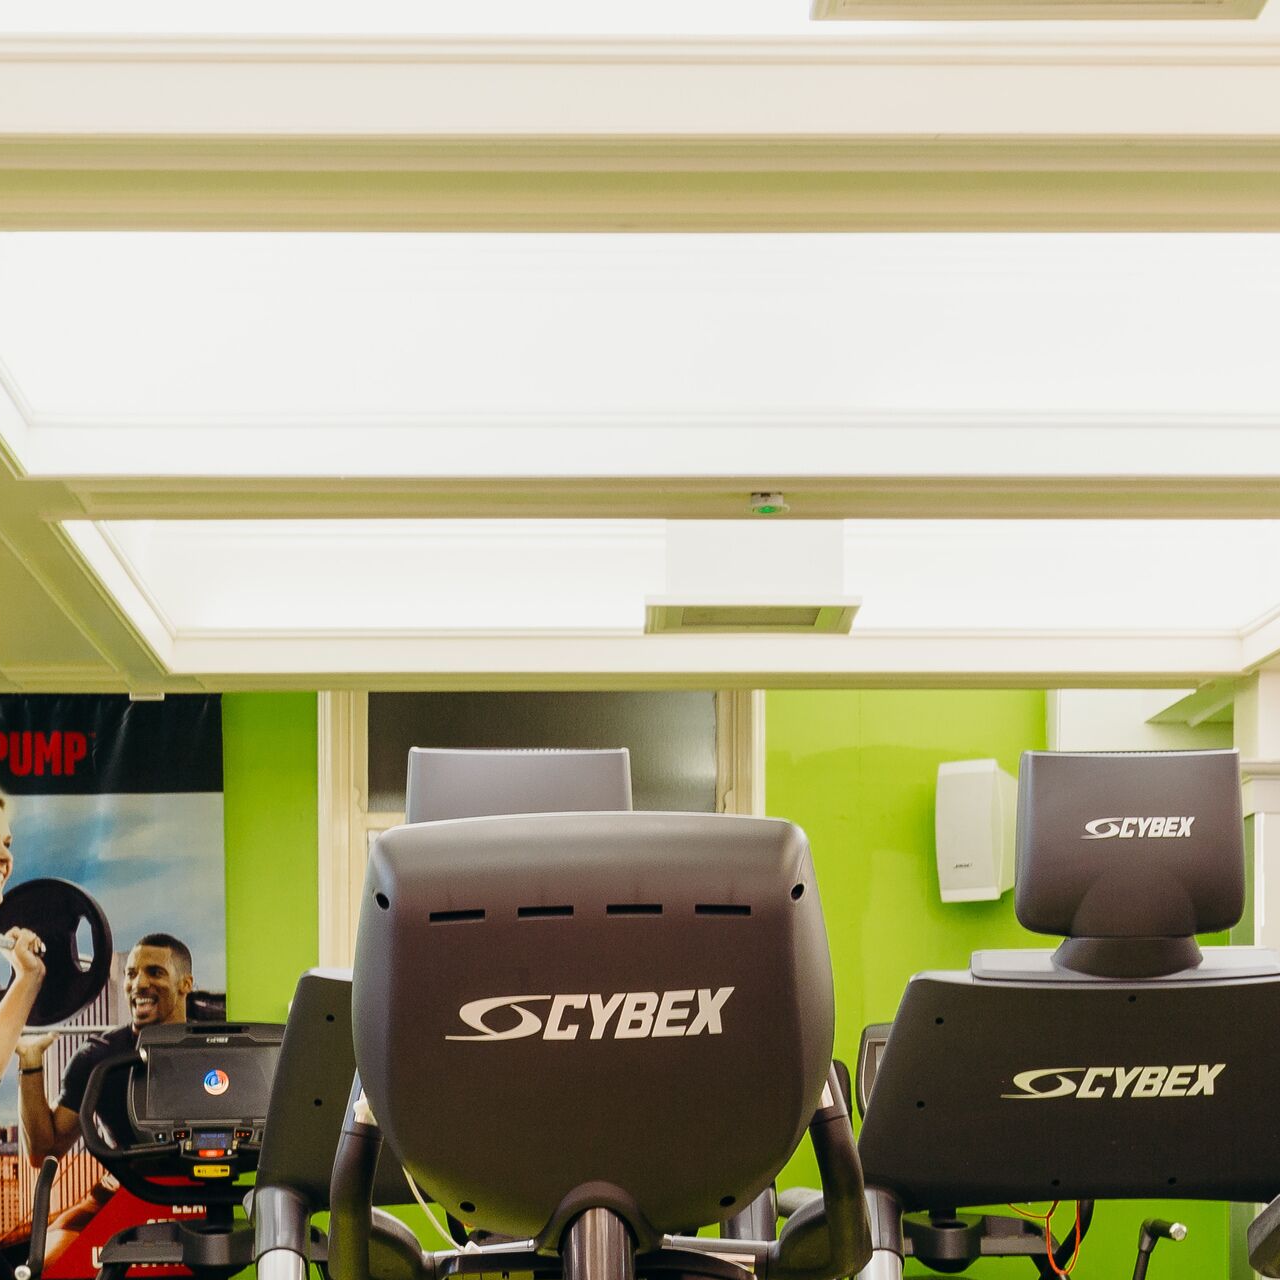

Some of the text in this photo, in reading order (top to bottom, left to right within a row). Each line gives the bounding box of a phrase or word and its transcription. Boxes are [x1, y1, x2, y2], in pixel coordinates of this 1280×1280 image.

[1119, 816, 1195, 838] CYBEX
[542, 986, 736, 1042] CYBEX
[1076, 1063, 1227, 1099] CYBEX
